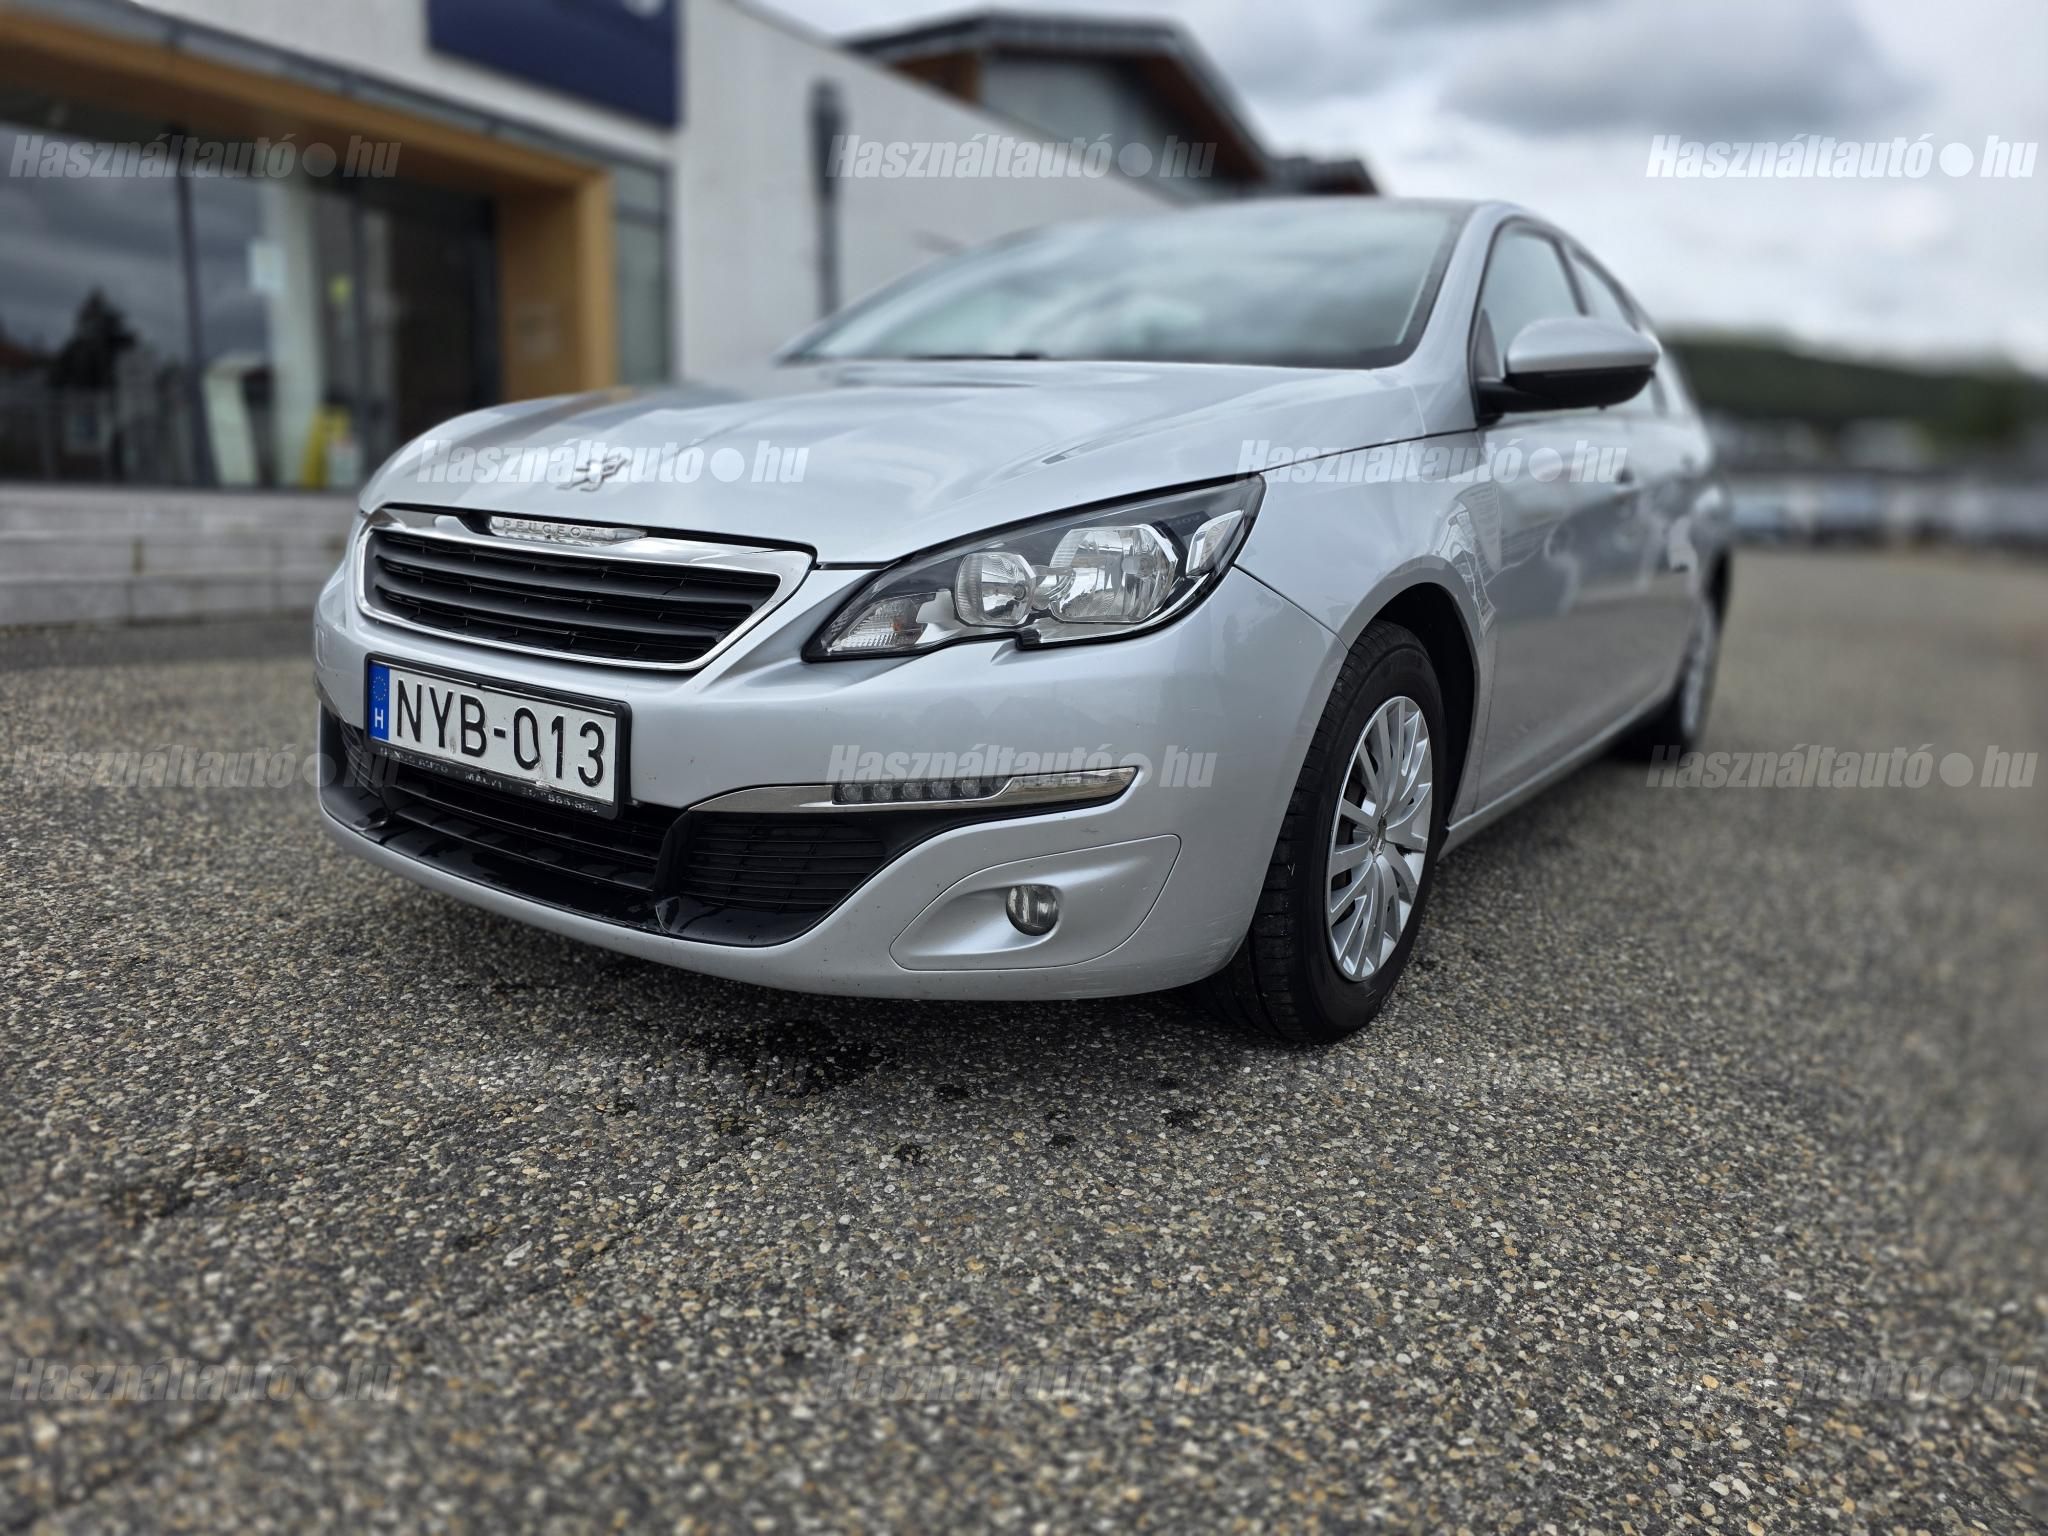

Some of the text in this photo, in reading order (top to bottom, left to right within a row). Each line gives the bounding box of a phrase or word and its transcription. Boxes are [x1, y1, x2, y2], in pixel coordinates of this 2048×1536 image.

[503, 518, 596, 542] PEUGEOT
[374, 707, 384, 730] H
[396, 679, 606, 788] NYB-013
